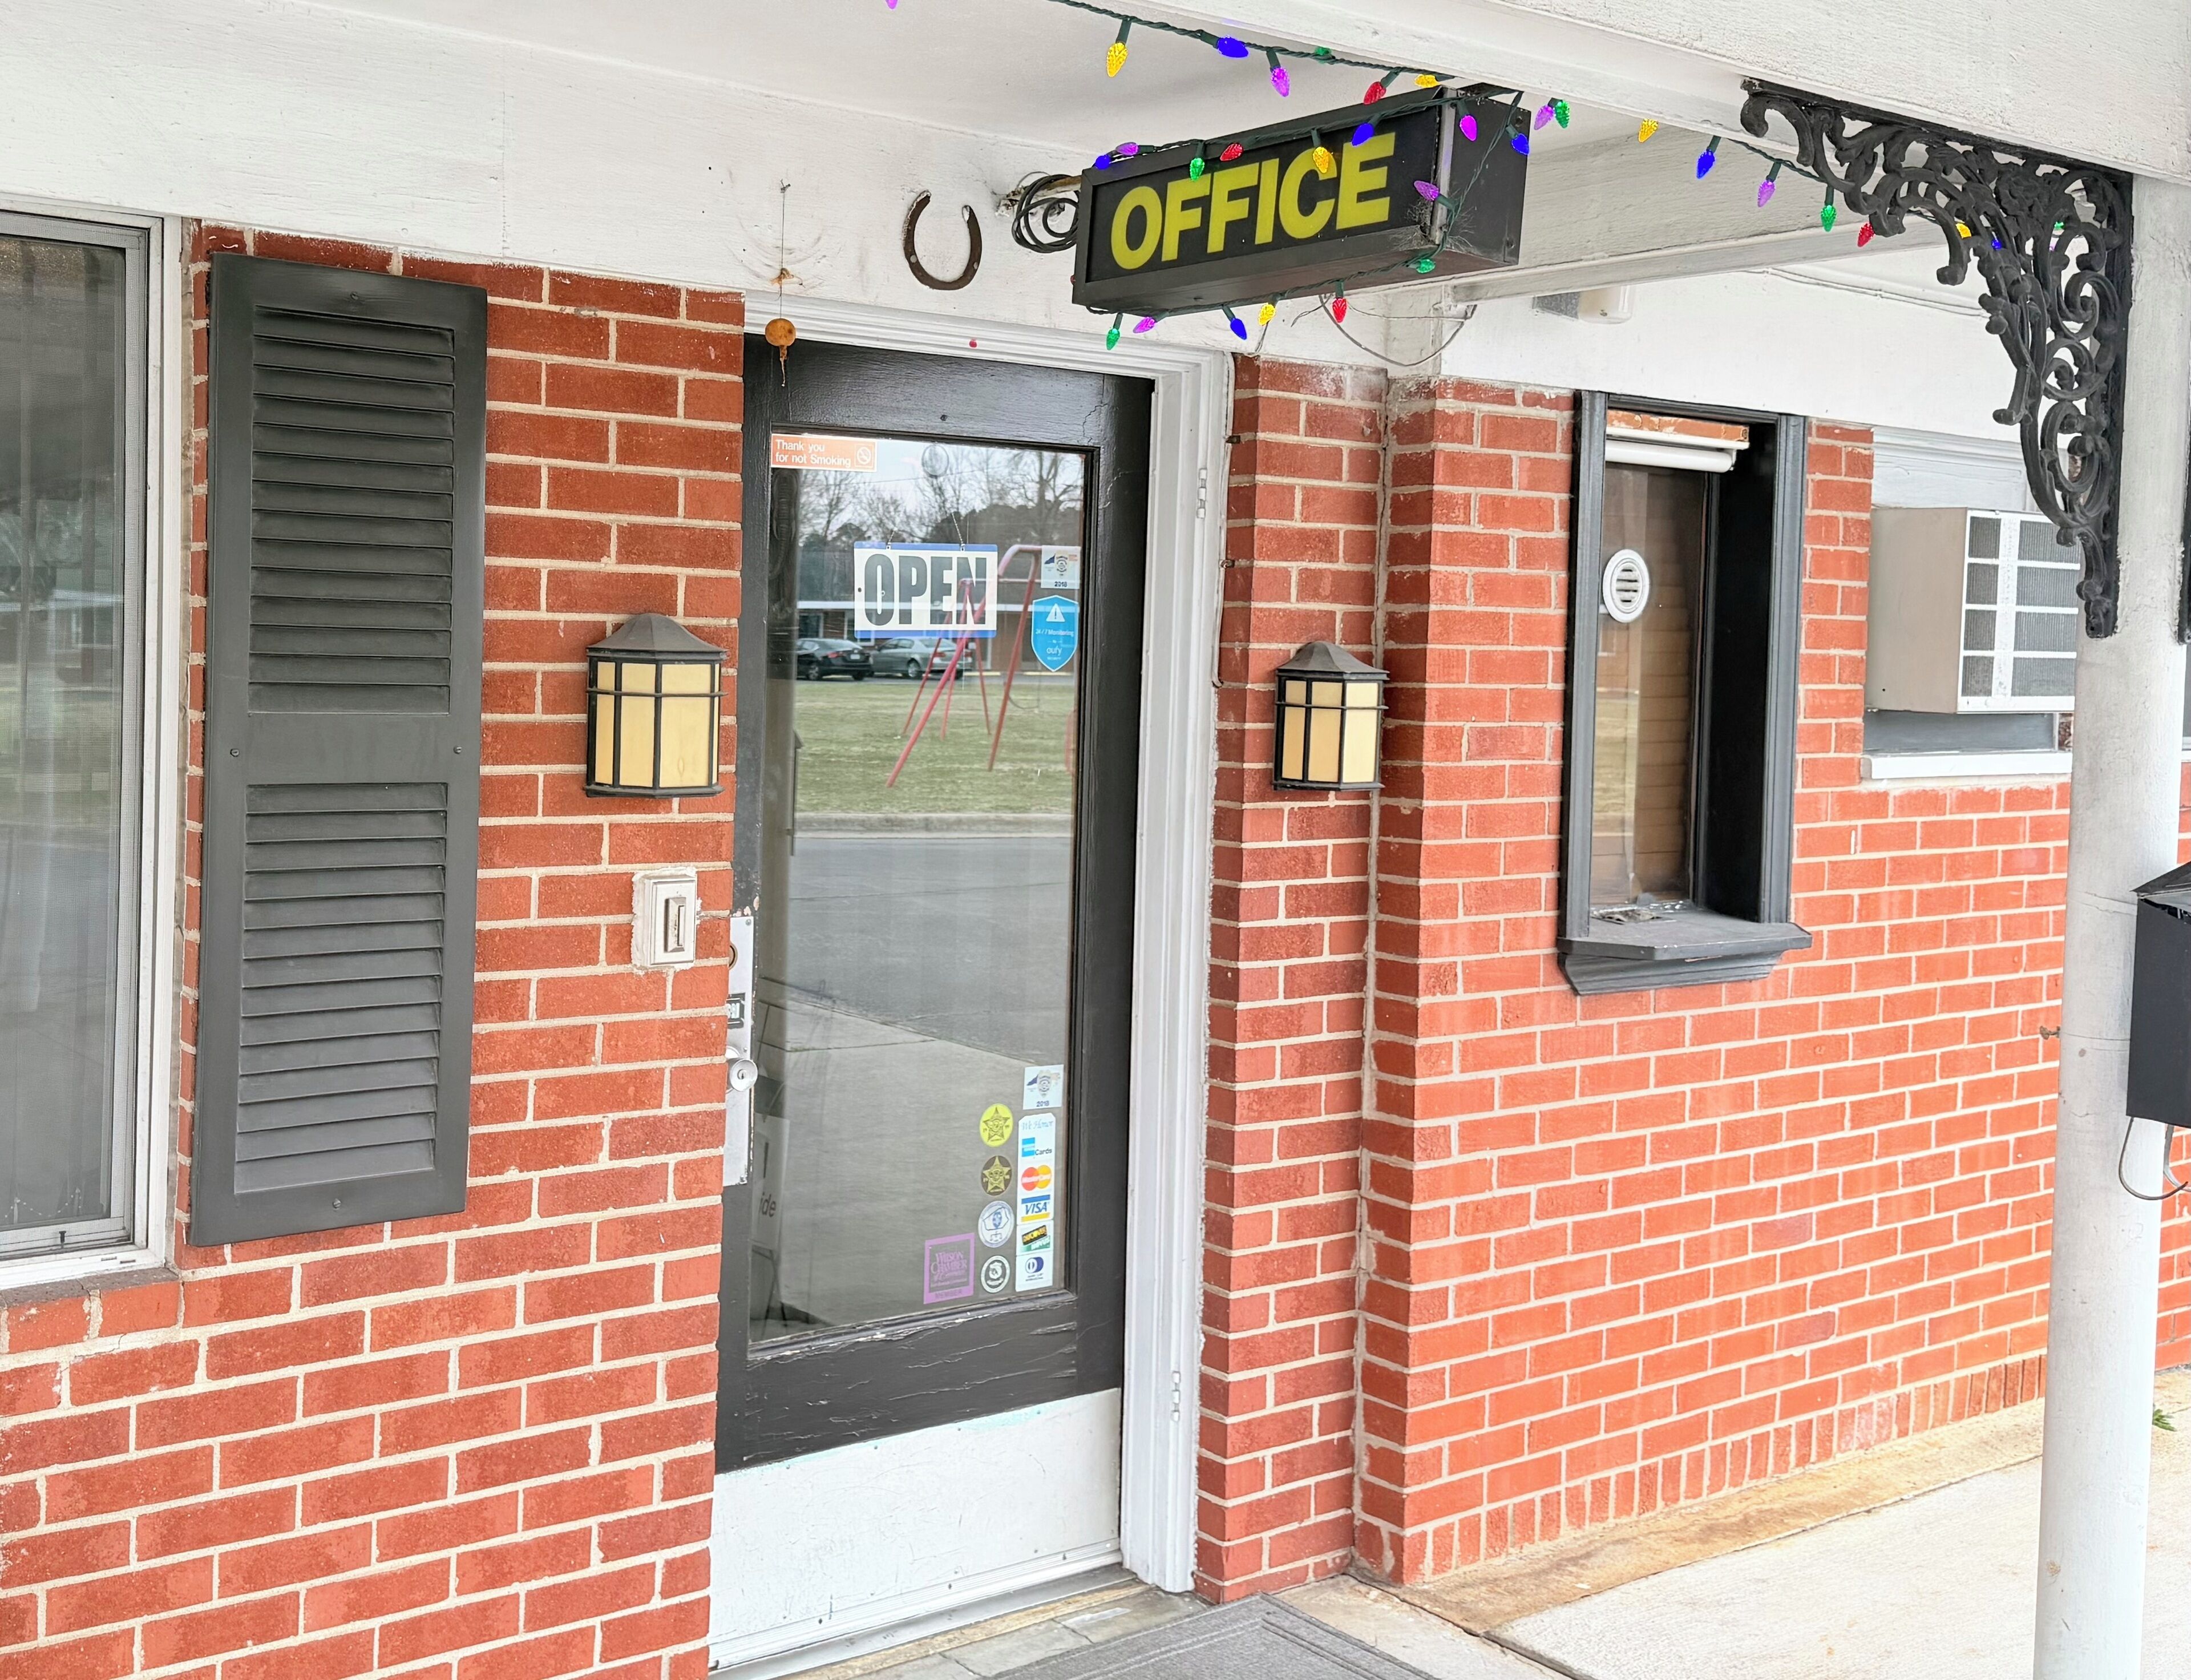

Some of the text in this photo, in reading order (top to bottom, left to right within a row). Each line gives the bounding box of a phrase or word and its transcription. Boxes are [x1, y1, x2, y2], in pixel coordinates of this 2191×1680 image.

[1110, 132, 1396, 270] OFFICE
[775, 439, 825, 453] Thank you
[775, 451, 851, 468] for not Smoking
[863, 553, 987, 625] OPEN
[1025, 1201, 1048, 1214] VISA
